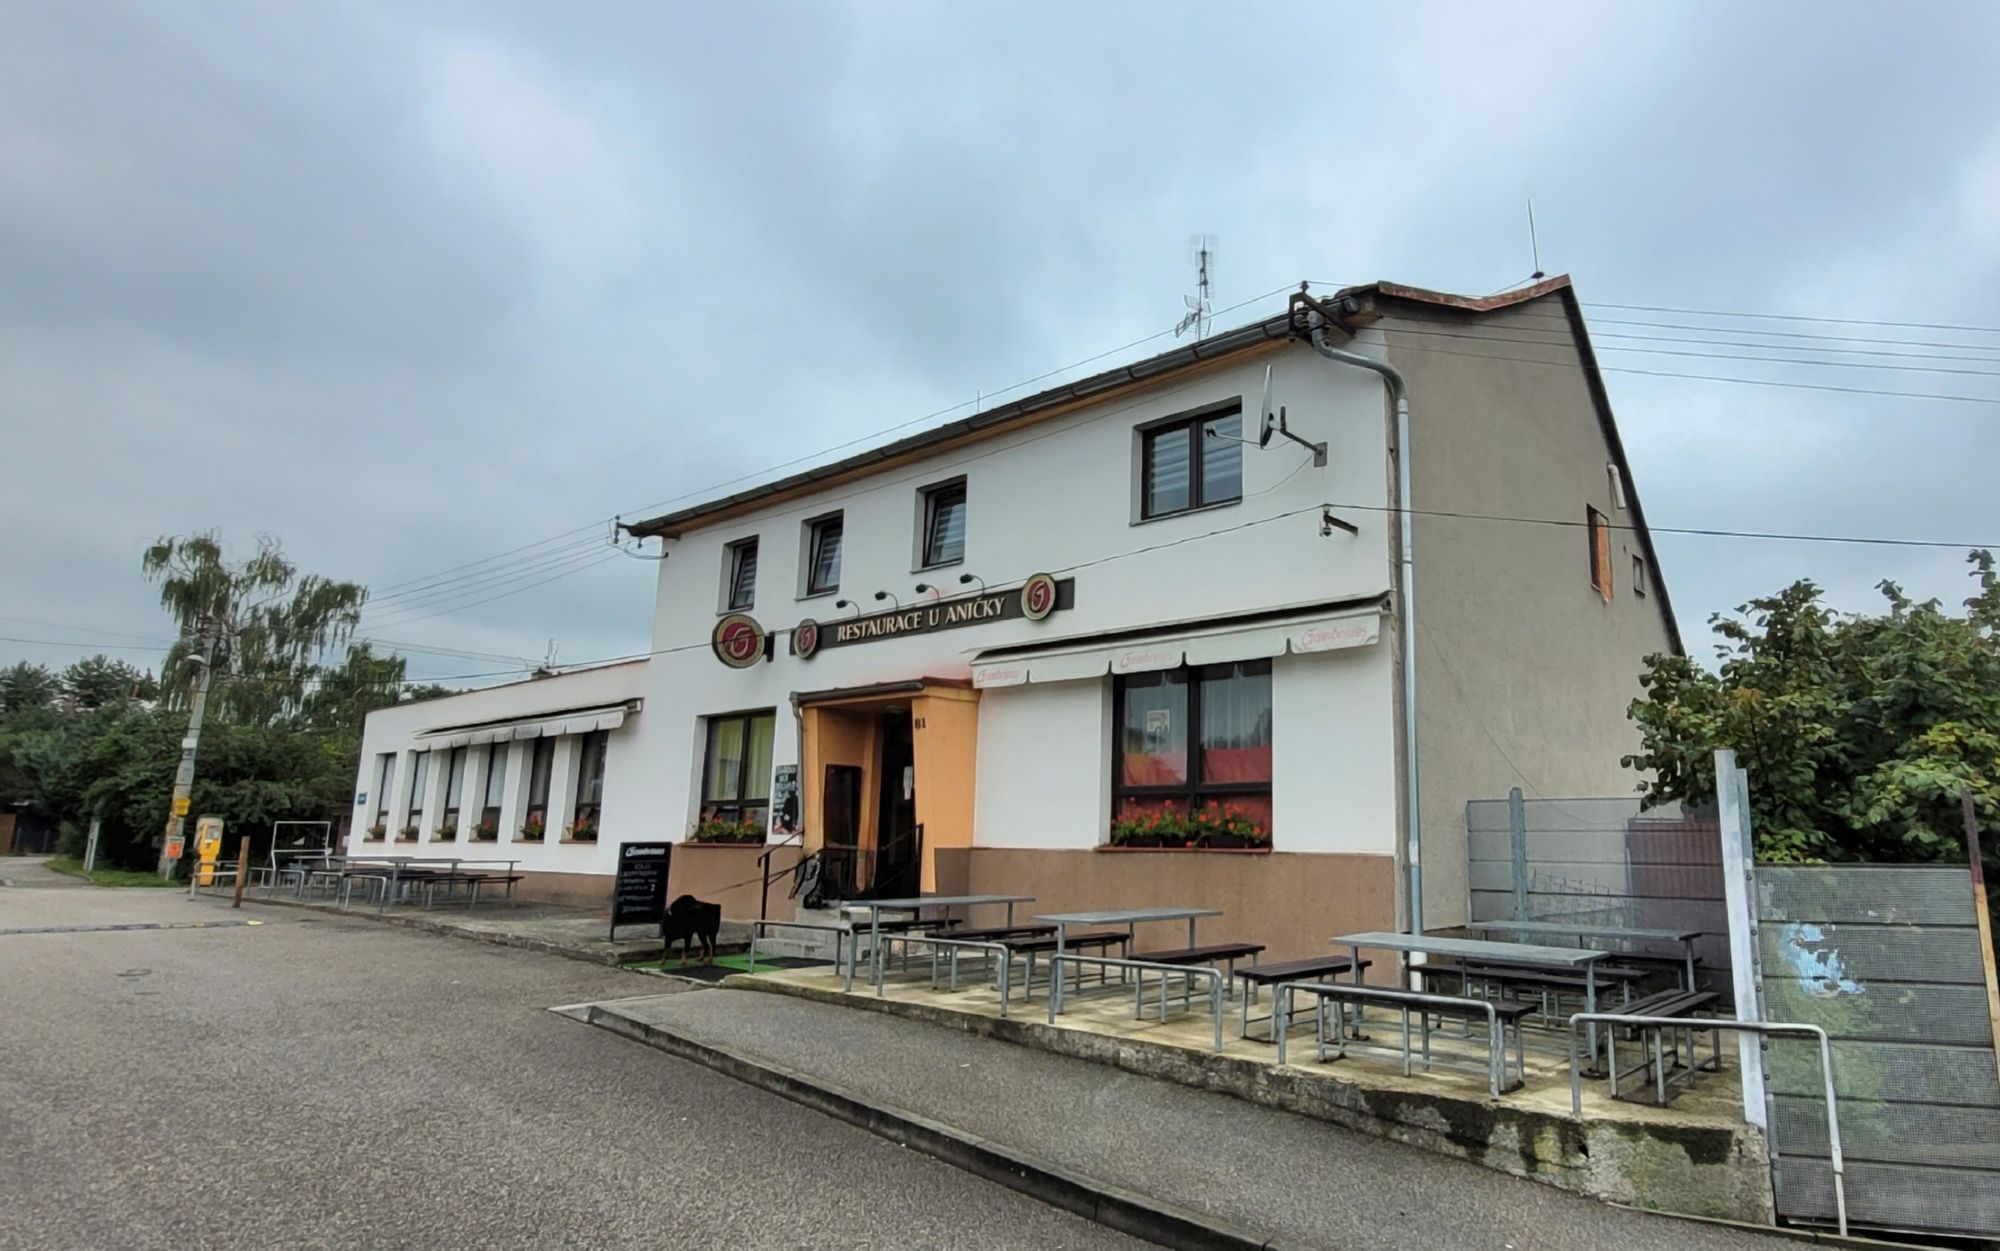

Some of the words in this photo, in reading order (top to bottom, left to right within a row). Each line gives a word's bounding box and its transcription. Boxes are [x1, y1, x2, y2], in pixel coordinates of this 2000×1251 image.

[837, 611, 923, 642] RESTAURACE
[929, 609, 940, 626] U
[945, 596, 1006, 624] ANIČKY
